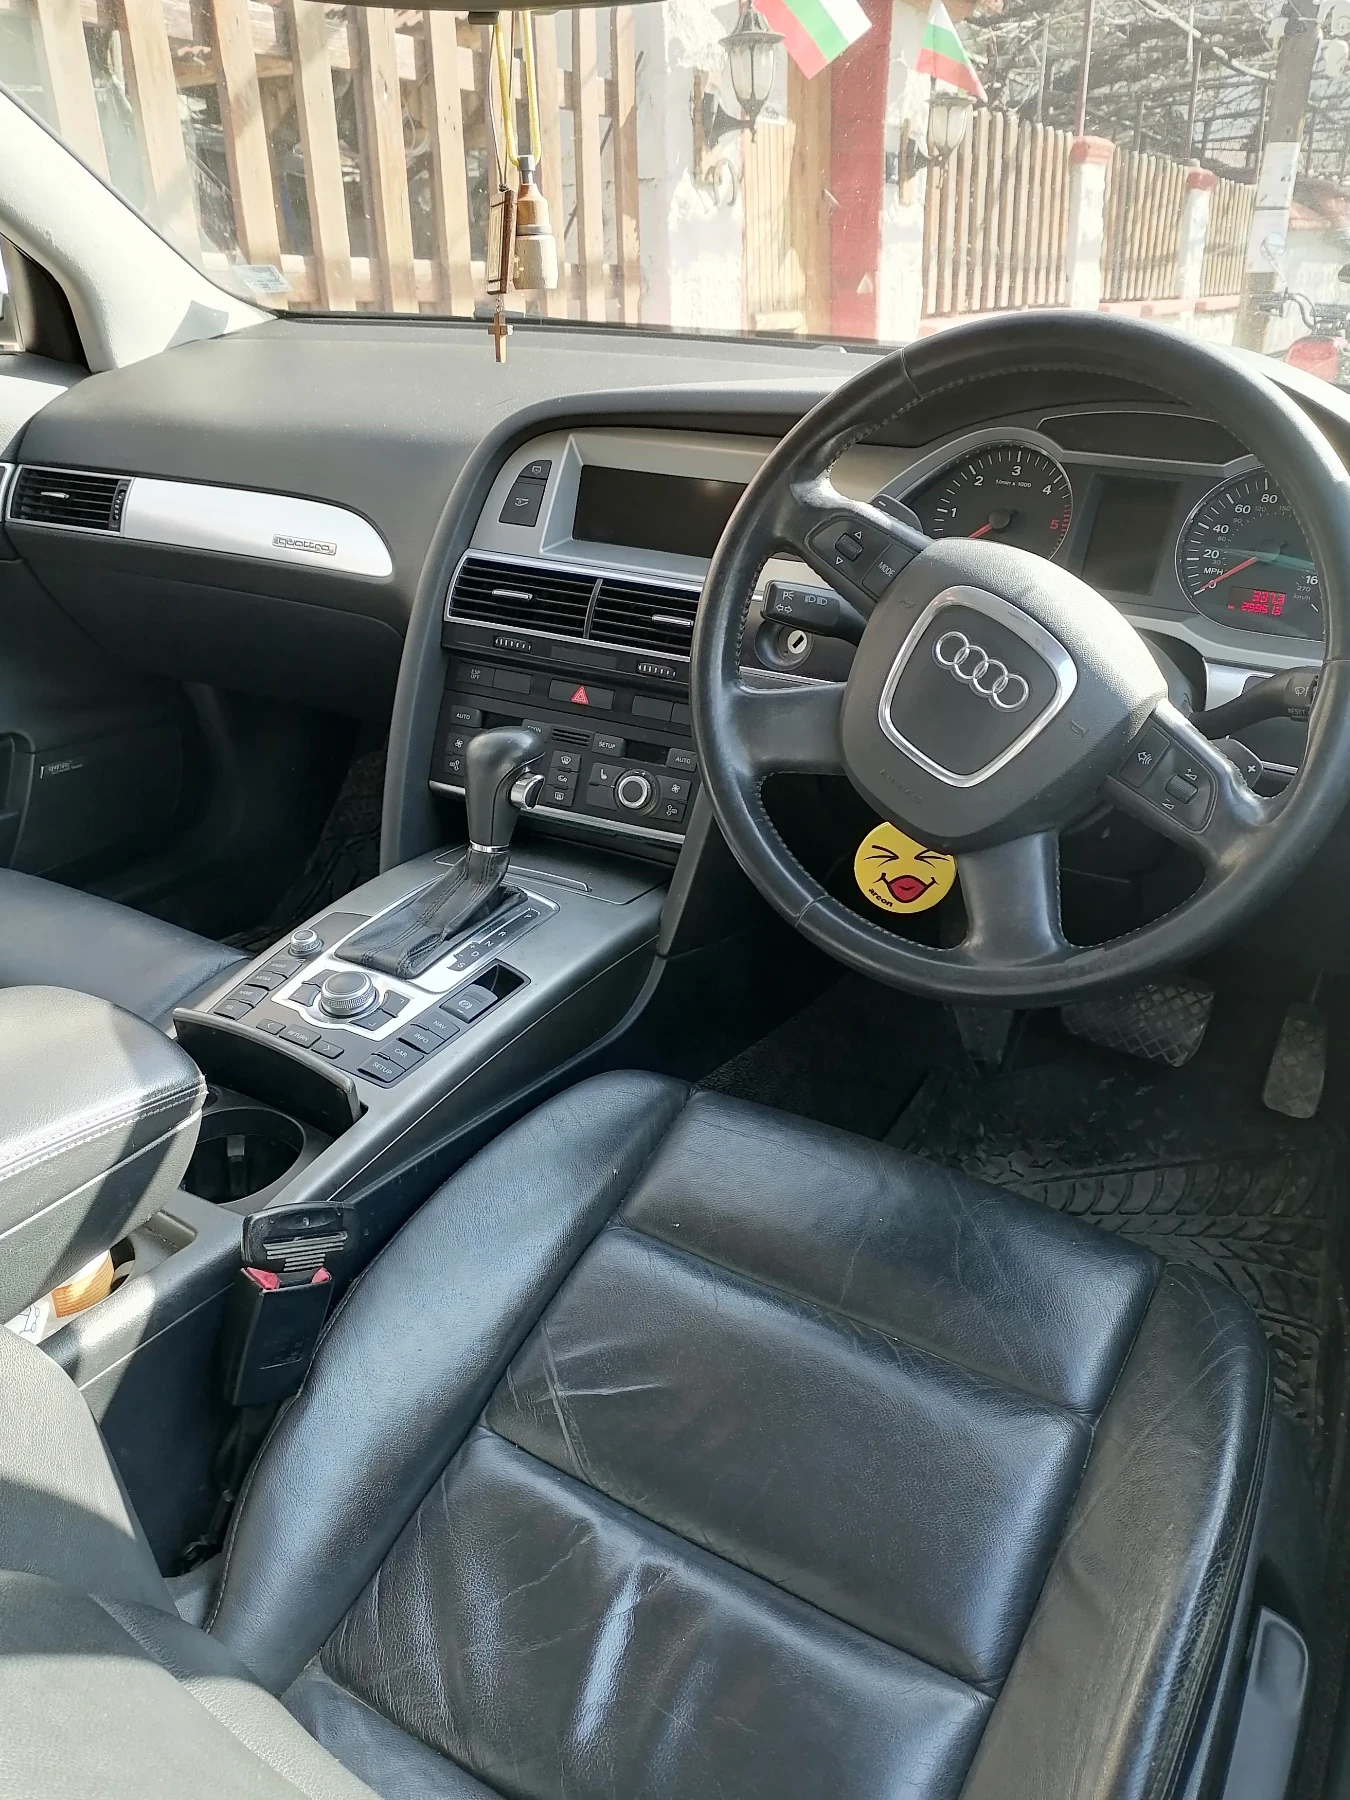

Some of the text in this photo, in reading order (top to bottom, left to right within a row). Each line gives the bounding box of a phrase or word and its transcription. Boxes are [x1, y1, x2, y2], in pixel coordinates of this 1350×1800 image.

[1011, 466, 1021, 476] 3
[974, 475, 984, 486] 2
[1042, 484, 1052, 495] 4
[1261, 494, 1278, 504] 80
[951, 507, 957, 518] 1
[1234, 504, 1251, 514] 60
[1049, 519, 1060, 530] 5
[1212, 524, 1229, 534] 40
[278, 537, 330, 552] quattro
[1203, 549, 1220, 559] 20
[877, 561, 896, 578] MODE
[1203, 567, 1224, 576] MPH
[1305, 575, 1319, 585] 16
[1293, 594, 1311, 602] km/h
[456, 712, 471, 720] AUTO
[1287, 707, 1306, 715] RESET
[598, 741, 616, 749] SETUP
[675, 756, 691, 764] AUTO
[868, 888, 894, 908] areon
[433, 1020, 448, 1030] NAV
[287, 1029, 310, 1042] RETURN
[414, 1032, 429, 1044] INFO
[394, 1048, 408, 1058] CAR
[372, 1061, 393, 1075] SETUP
